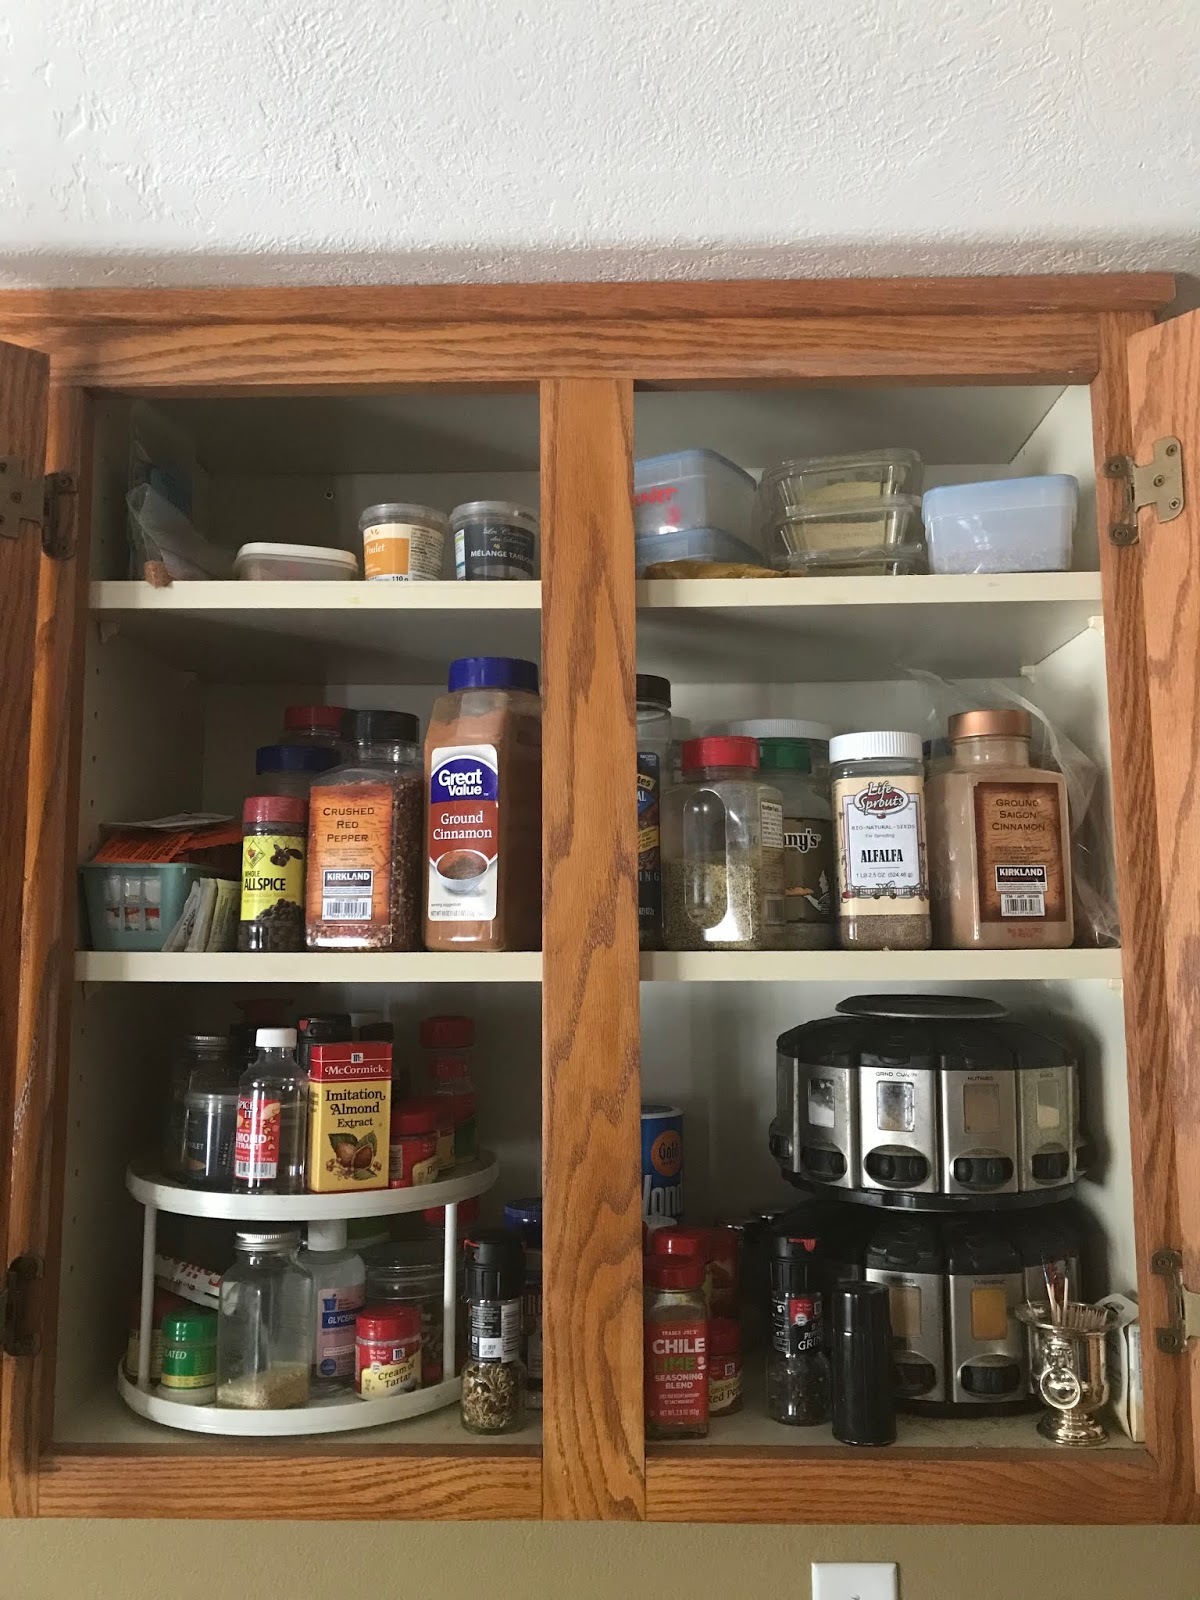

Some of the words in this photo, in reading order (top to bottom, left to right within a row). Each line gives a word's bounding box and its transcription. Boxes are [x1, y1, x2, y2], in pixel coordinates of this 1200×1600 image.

[470, 549, 508, 558] MÉLANGE
[438, 768, 482, 787] Great
[448, 784, 482, 796] Value
[868, 781, 893, 799] Life
[859, 795, 905, 816] Sprouts
[996, 798, 1039, 807] GROUND
[323, 807, 375, 816] CRUSHED
[1000, 810, 1037, 819] SAIGON
[441, 810, 484, 825] Ground
[336, 820, 359, 829] RED
[992, 822, 1045, 831] CINNAMON
[327, 833, 369, 842] PEPPER
[433, 829, 493, 841] Cinnamon
[861, 849, 904, 863] ALFALFA
[245, 870, 260, 878] WHOLE
[327, 872, 370, 881] KIRKLAND
[1000, 868, 1043, 877] KIRKLAND
[244, 877, 286, 891] ALLSPICE
[325, 1064, 385, 1075] McCormick
[326, 1088, 386, 1101] Imitation
[330, 1102, 380, 1115] Almond
[337, 1117, 373, 1128] Extract
[652, 1337, 706, 1354] CHILE
[378, 1365, 406, 1381] Cream
[655, 1373, 703, 1382] SEASONING
[385, 1372, 412, 1388] Tartar
[665, 1382, 693, 1390] BLEND
